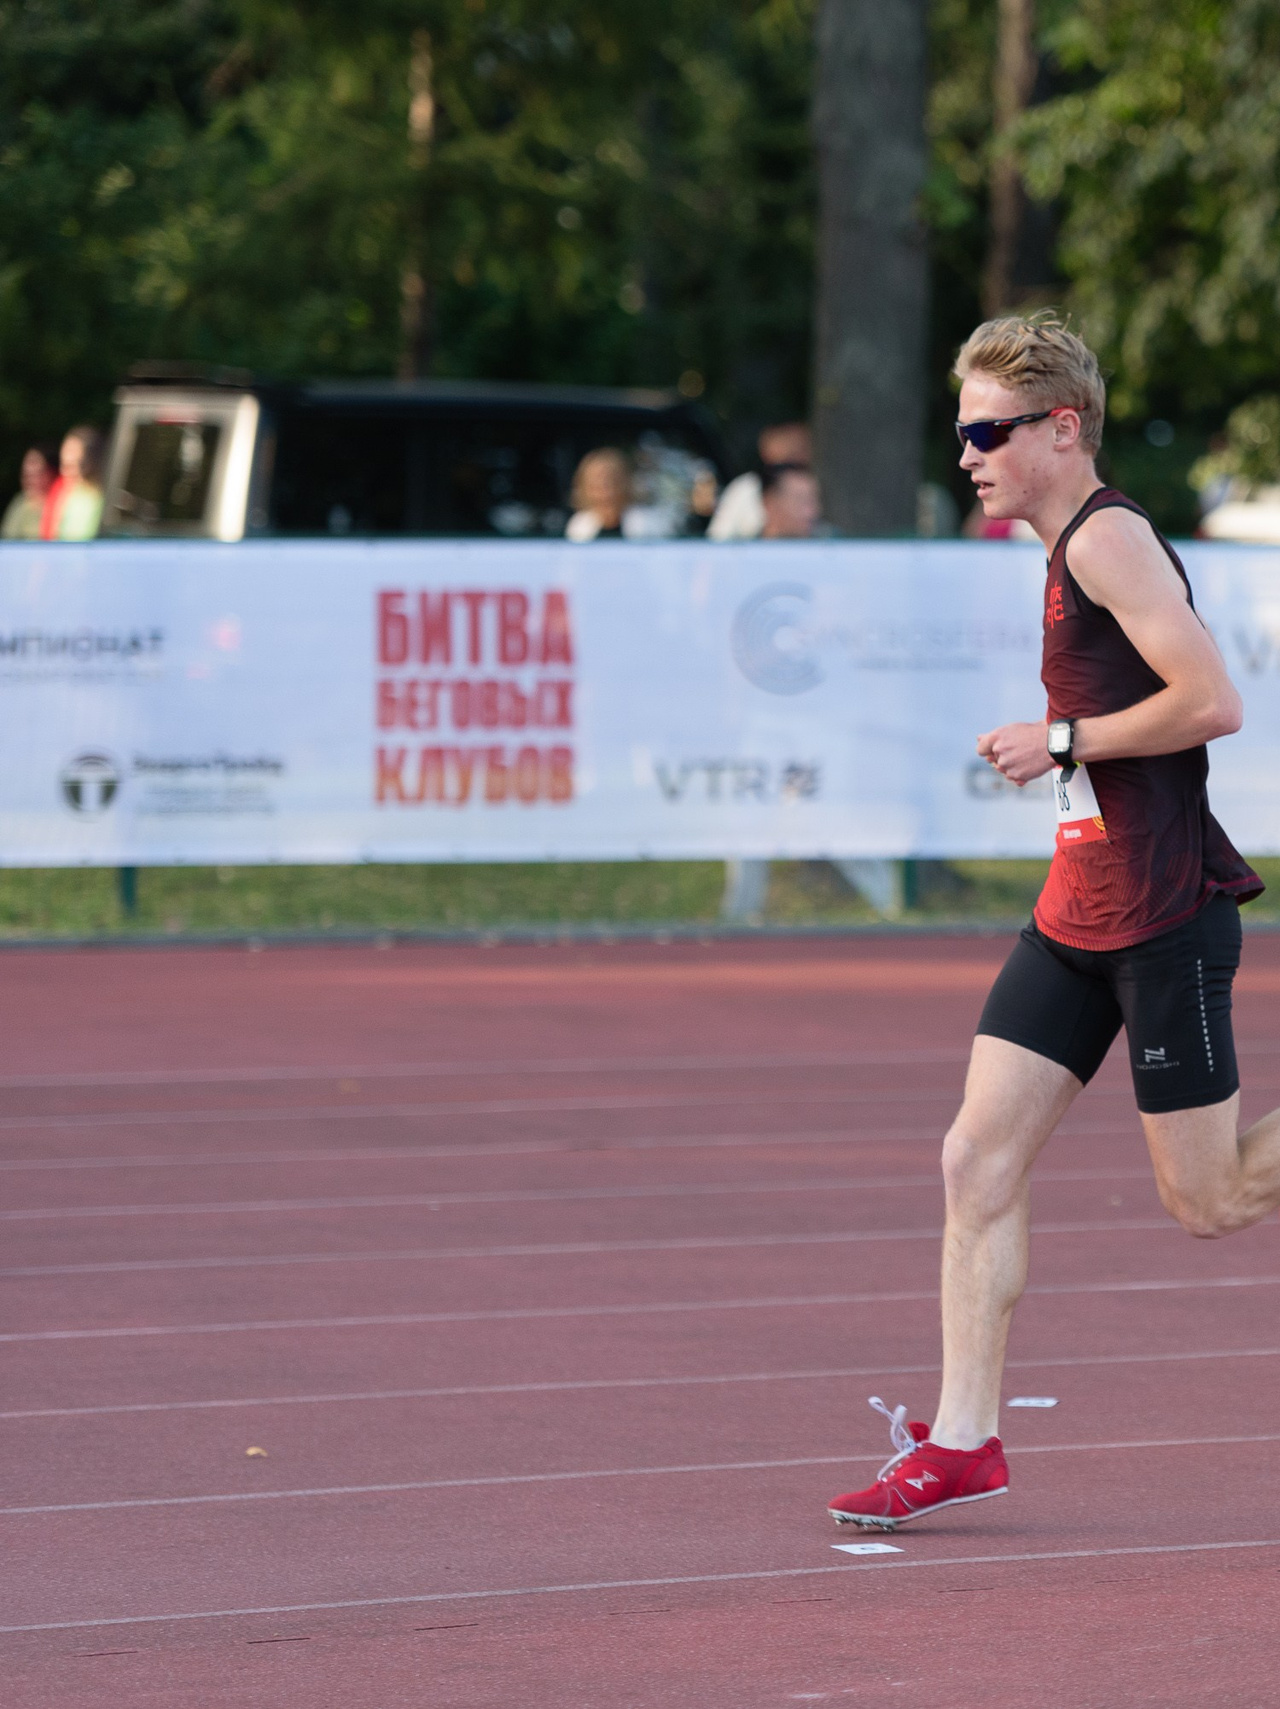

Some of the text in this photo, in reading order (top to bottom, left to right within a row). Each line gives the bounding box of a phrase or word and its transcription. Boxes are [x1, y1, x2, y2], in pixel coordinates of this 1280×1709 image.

[377, 588, 573, 666] БИТВА
[377, 679, 573, 729] БЕГОВЫХ
[376, 745, 574, 804] КЛУБОВ
